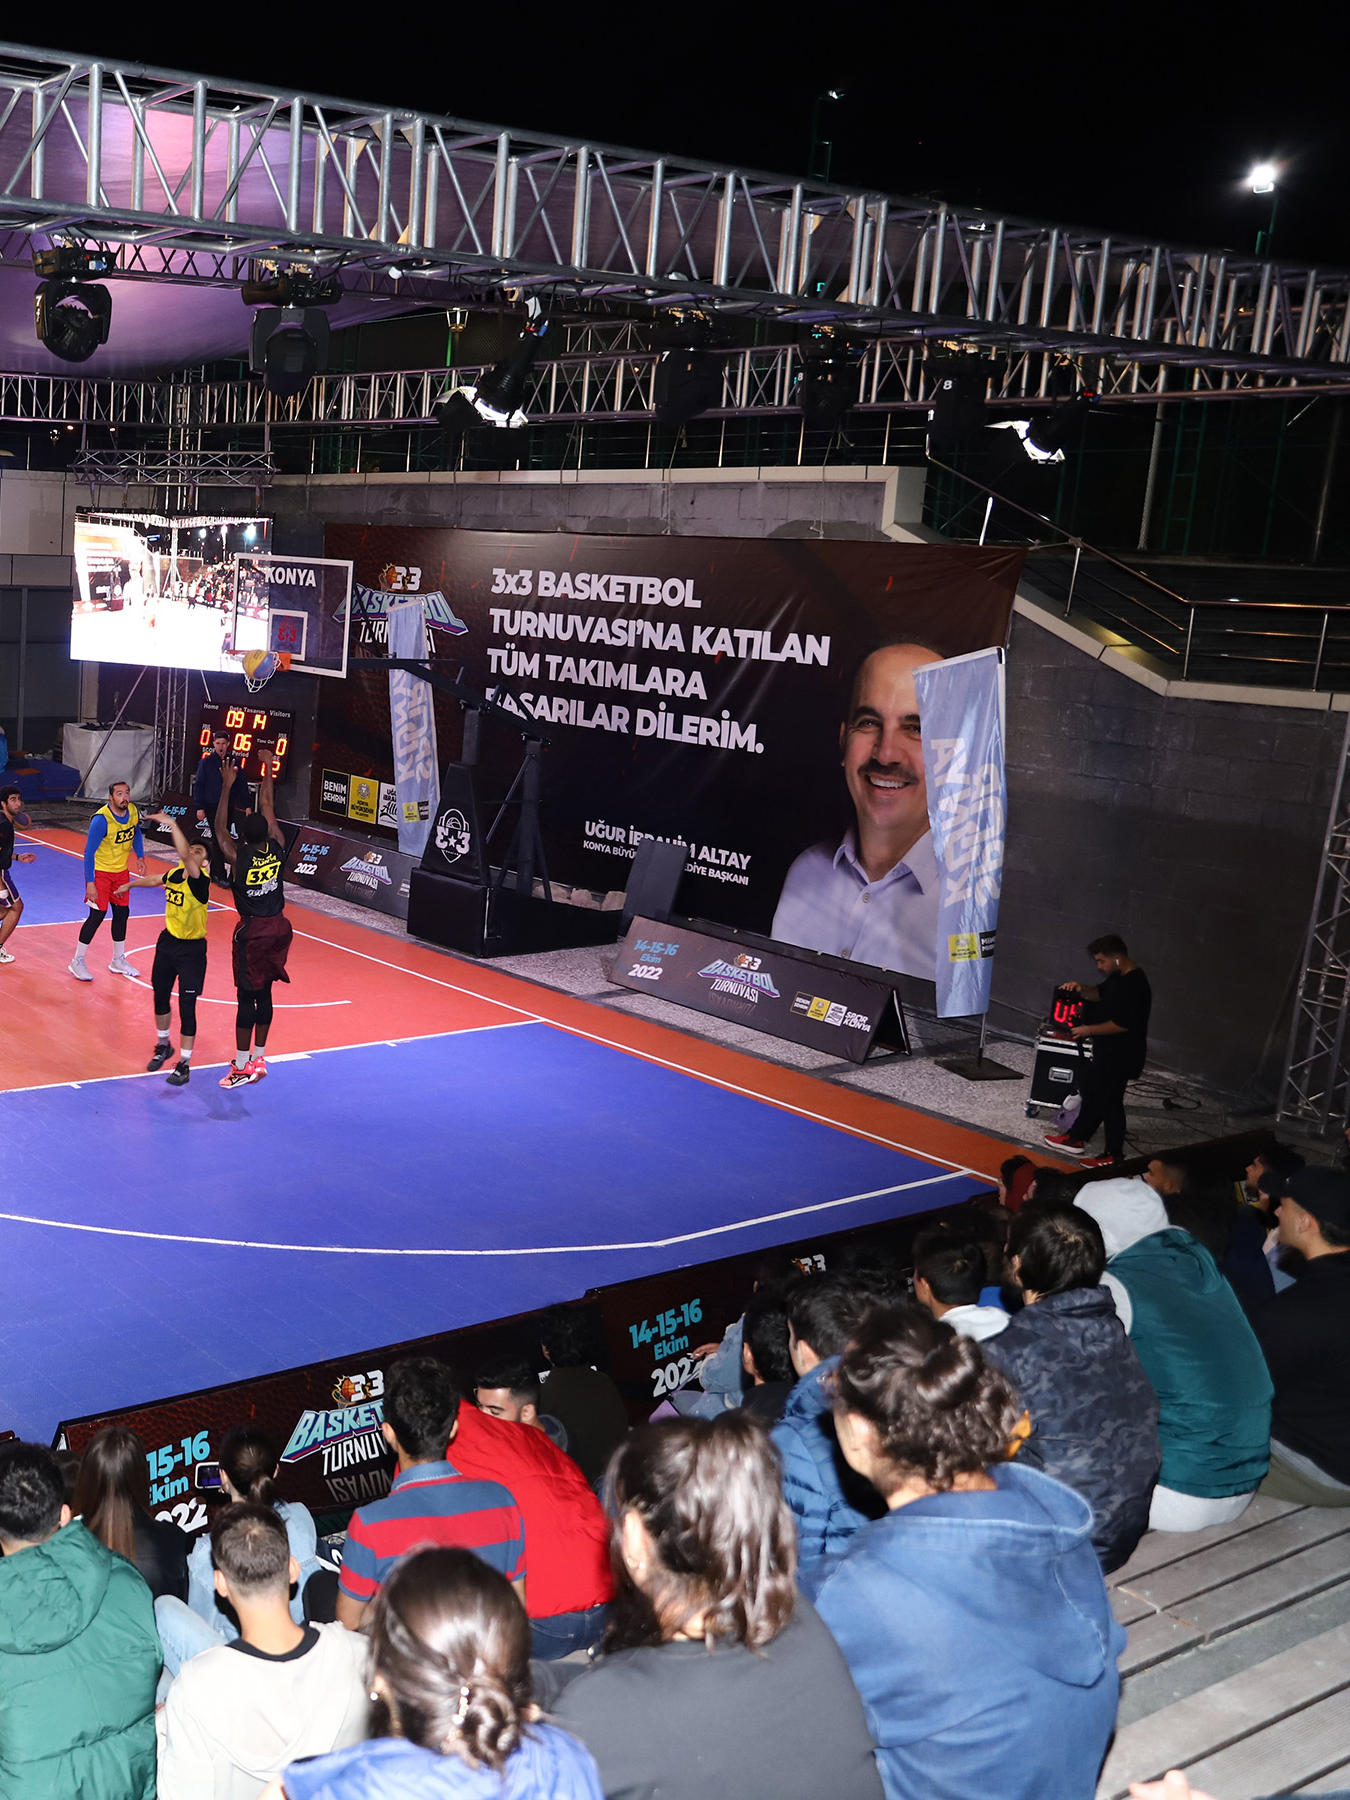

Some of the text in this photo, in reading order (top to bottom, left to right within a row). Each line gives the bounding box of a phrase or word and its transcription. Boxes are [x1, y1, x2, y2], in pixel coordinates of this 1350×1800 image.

[264, 566, 317, 587] KONYA
[490, 567, 702, 609] 3x3 BASKETBOL
[691, 624, 832, 668] KATILAN
[486, 642, 709, 700] TÜM TAKIMLARA
[225, 710, 268, 730] 09 14
[269, 709, 291, 719] Visitors
[634, 701, 765, 754] DİLERİM.
[233, 732, 253, 752] 06
[299, 843, 331, 856] 14-15-16
[582, 840, 612, 855] KONYA
[584, 819, 626, 844] UĞUR
[697, 845, 752, 871] ALTAY
[294, 862, 319, 875] 2022
[707, 868, 750, 886] BAŞKANI
[633, 939, 680, 957] 14-15-16
[639, 952, 662, 964] Ekim
[627, 963, 663, 981] 2022
[698, 959, 781, 998] BASKETBOL
[710, 978, 759, 1004] TURNUVASI
[628, 1298, 704, 1350] 14-15-16
[653, 1333, 690, 1361] Ekim
[149, 1475, 190, 1507] kim
